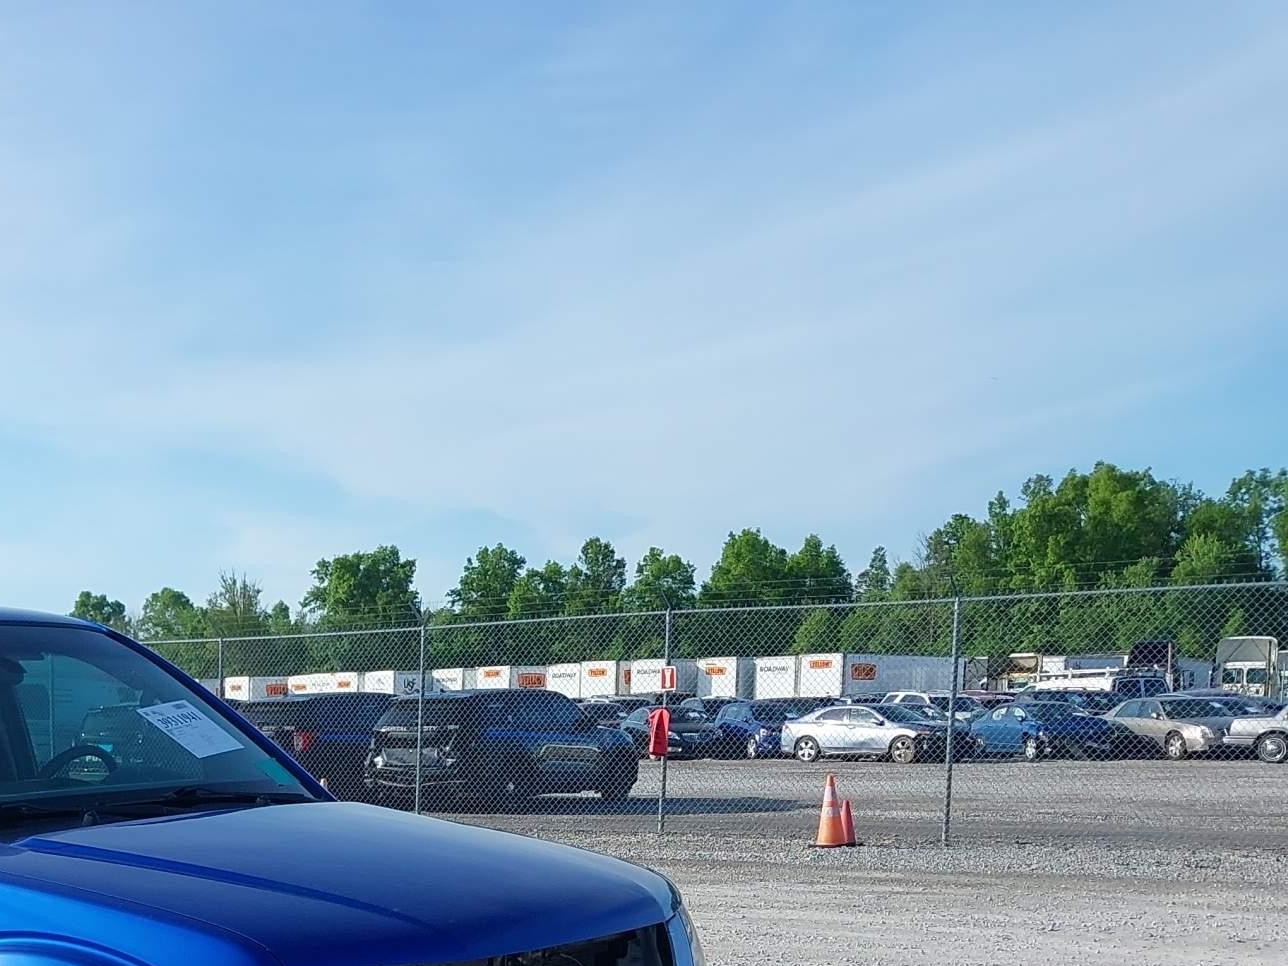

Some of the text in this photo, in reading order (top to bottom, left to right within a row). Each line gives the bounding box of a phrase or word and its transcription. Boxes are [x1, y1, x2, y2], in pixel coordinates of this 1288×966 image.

[636, 668, 661, 676] ROADWA
[759, 665, 790, 673] ROADWAY
[552, 672, 577, 680] ROADWAY
[157, 711, 202, 729] 39311941
